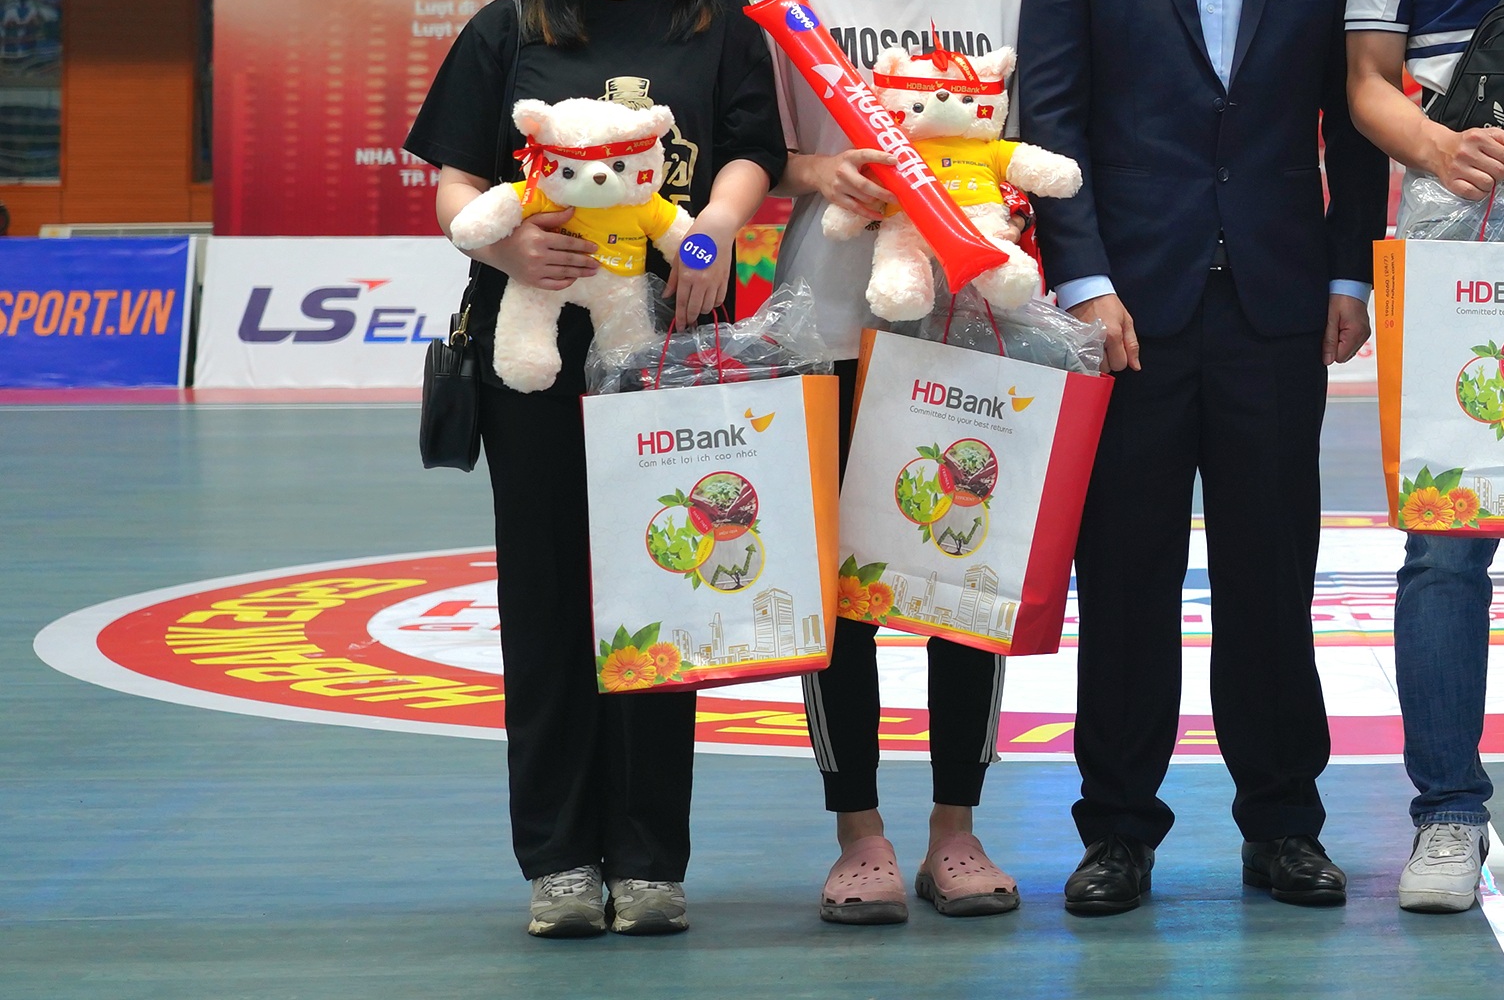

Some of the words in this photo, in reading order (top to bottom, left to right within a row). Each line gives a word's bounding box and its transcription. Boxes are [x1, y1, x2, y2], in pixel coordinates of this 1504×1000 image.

[906, 82, 936, 91] HDBank
[950, 85, 980, 93] HDBank
[844, 82, 937, 190] HDBank
[356, 148, 396, 166] NHA
[683, 240, 713, 264] 0154
[238, 286, 362, 345] LS
[1456, 307, 1498, 316] Committed
[911, 379, 1006, 420] HDBank
[909, 405, 948, 420] Committed
[948, 413, 956, 422] to
[957, 417, 972, 425] your
[973, 418, 989, 429] best
[990, 424, 1013, 435] returns
[637, 424, 747, 456] HDBank
[638, 459, 658, 469] Cam
[715, 452, 732, 461] cao
[177, 578, 427, 623] 2023
